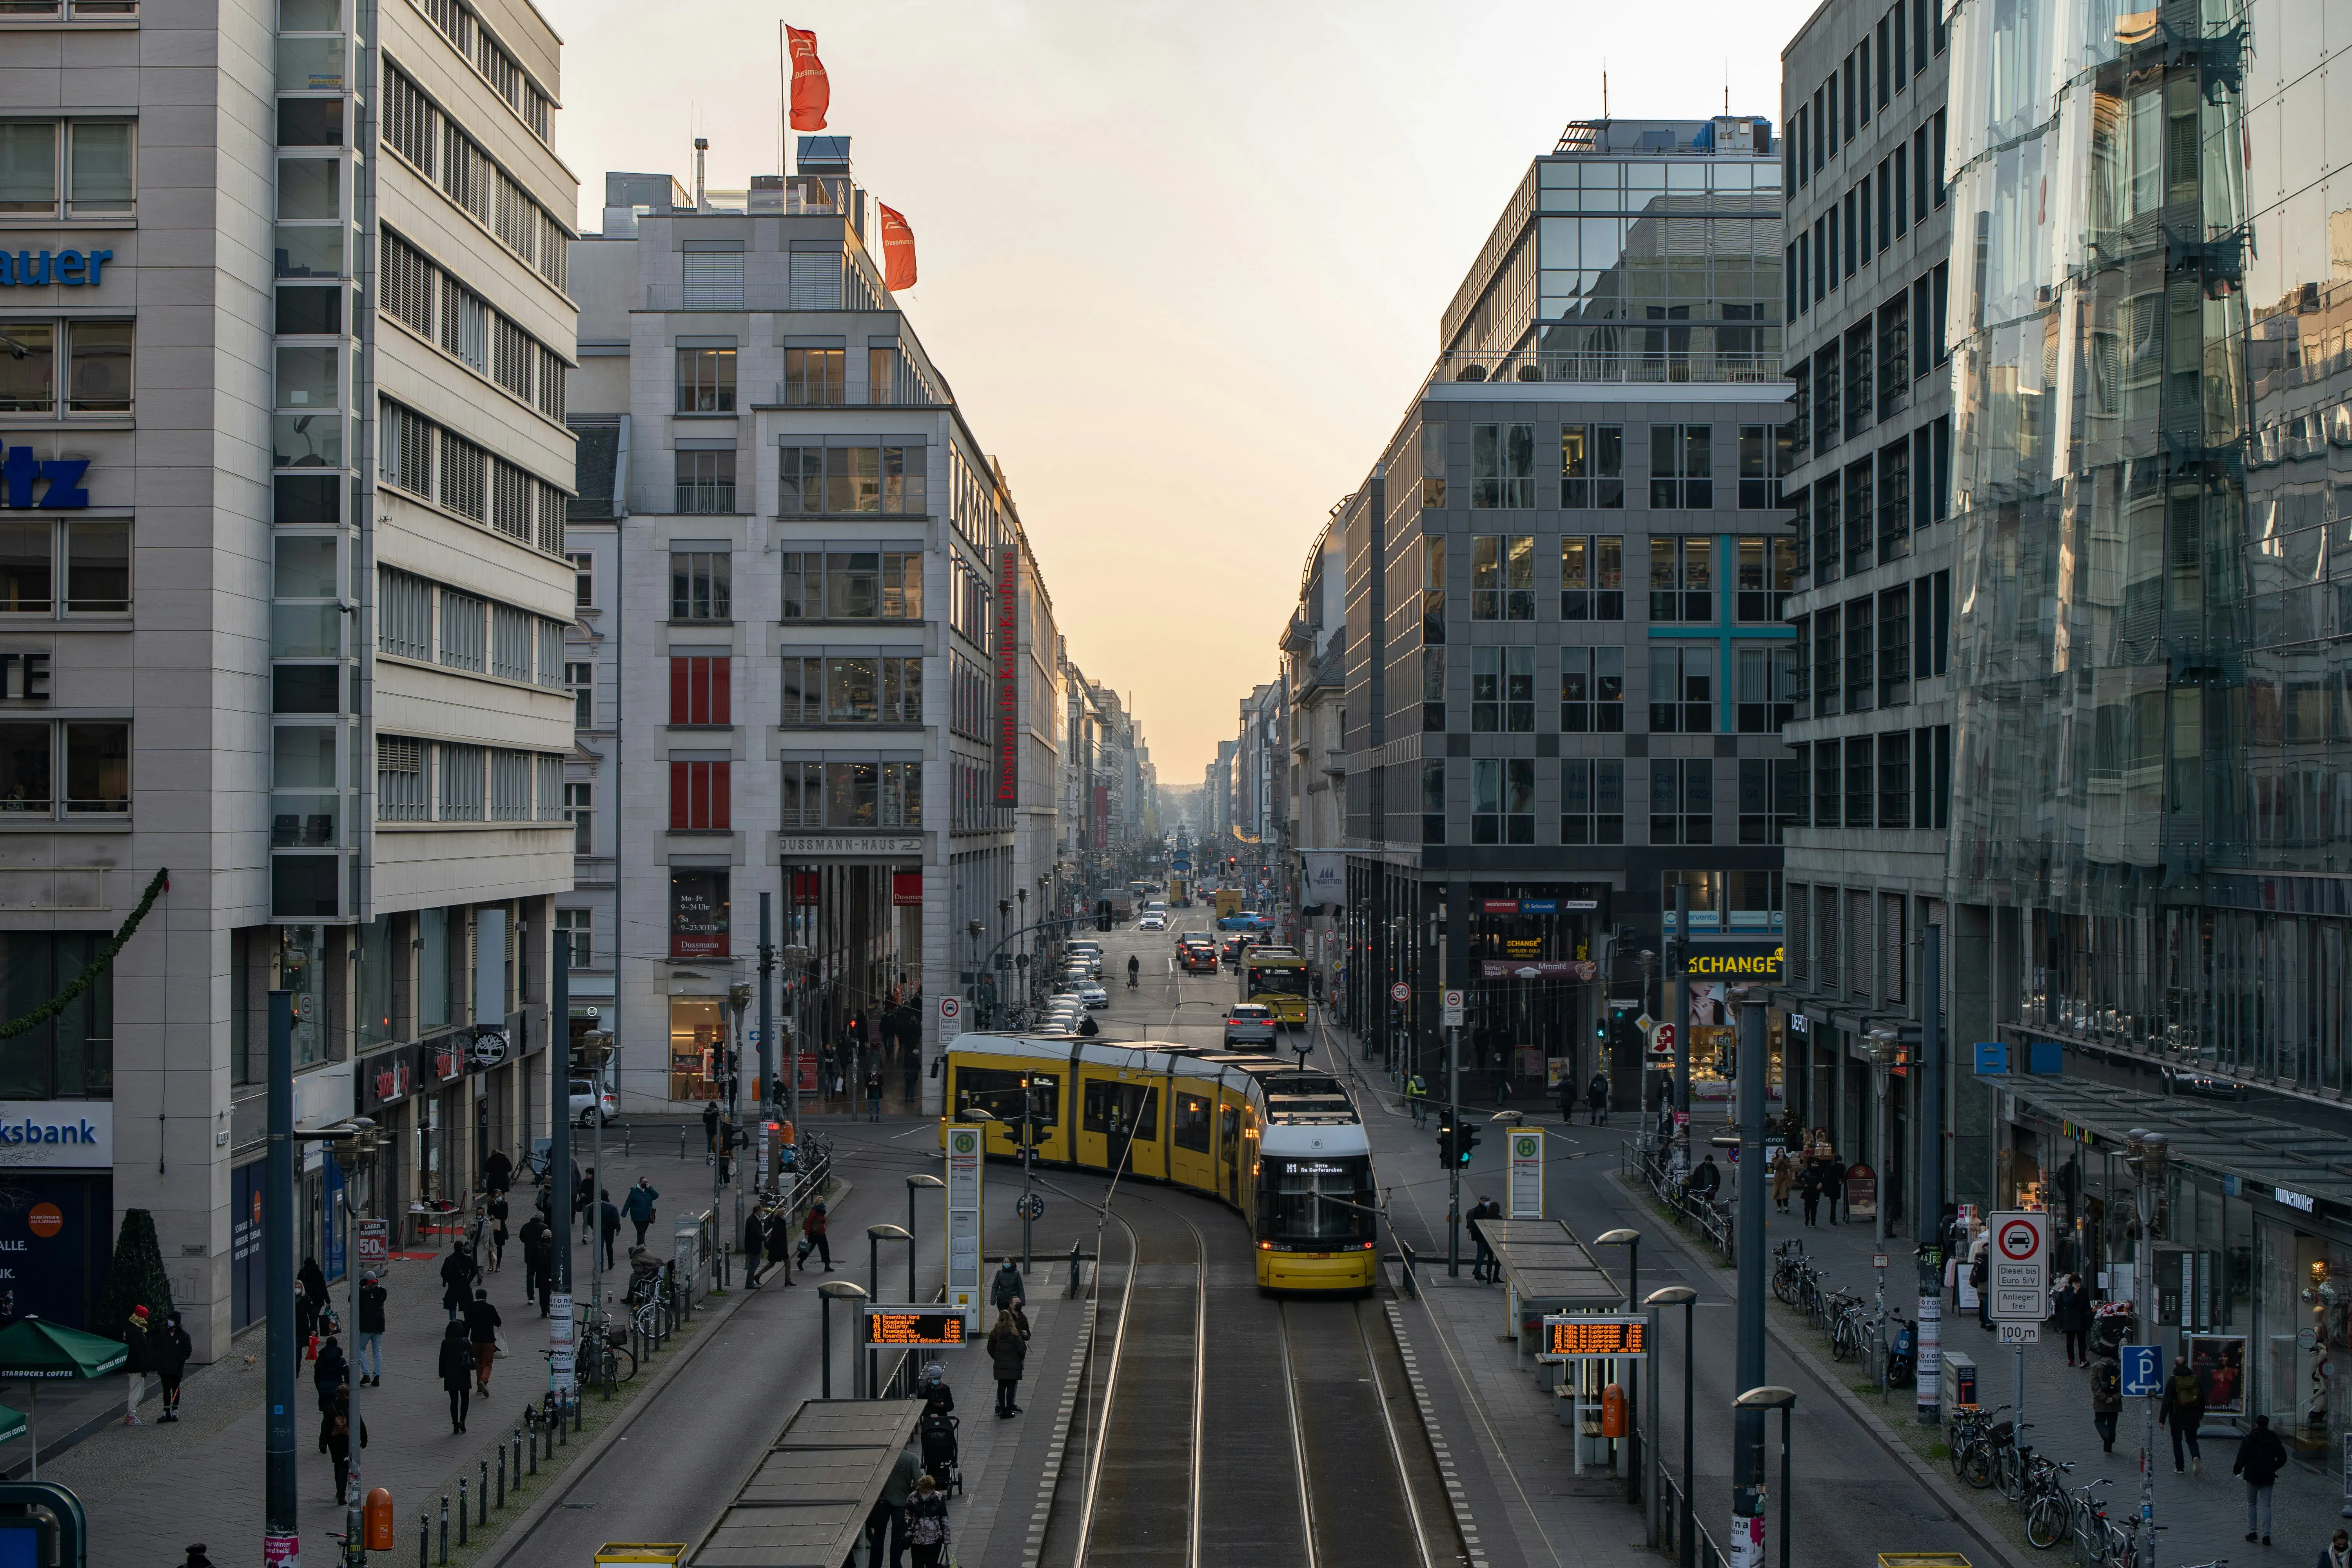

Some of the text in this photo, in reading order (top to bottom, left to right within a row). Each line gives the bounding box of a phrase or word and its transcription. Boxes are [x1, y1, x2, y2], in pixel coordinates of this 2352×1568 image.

[795, 68, 826, 79] Dussmann
[0, 437, 91, 507] tz
[999, 552, 1013, 799] Dussmann das KulturKaufhaus
[780, 840, 895, 850] DUSSMANN-HAUS
[1688, 956, 1777, 973] EXCHANGE
[1396, 987, 1406, 996] 30
[960, 1140, 969, 1149] H
[1523, 1142, 1531, 1153] H
[1287, 1164, 1296, 1172] M1
[2003, 1294, 2035, 1302] Anlieger
[2002, 1327, 2035, 1338] 100 m
[97, 1359, 115, 1372] STARBUCKS
[2140, 1359, 2154, 1383] P
[12, 1425, 27, 1435] COFFEE
